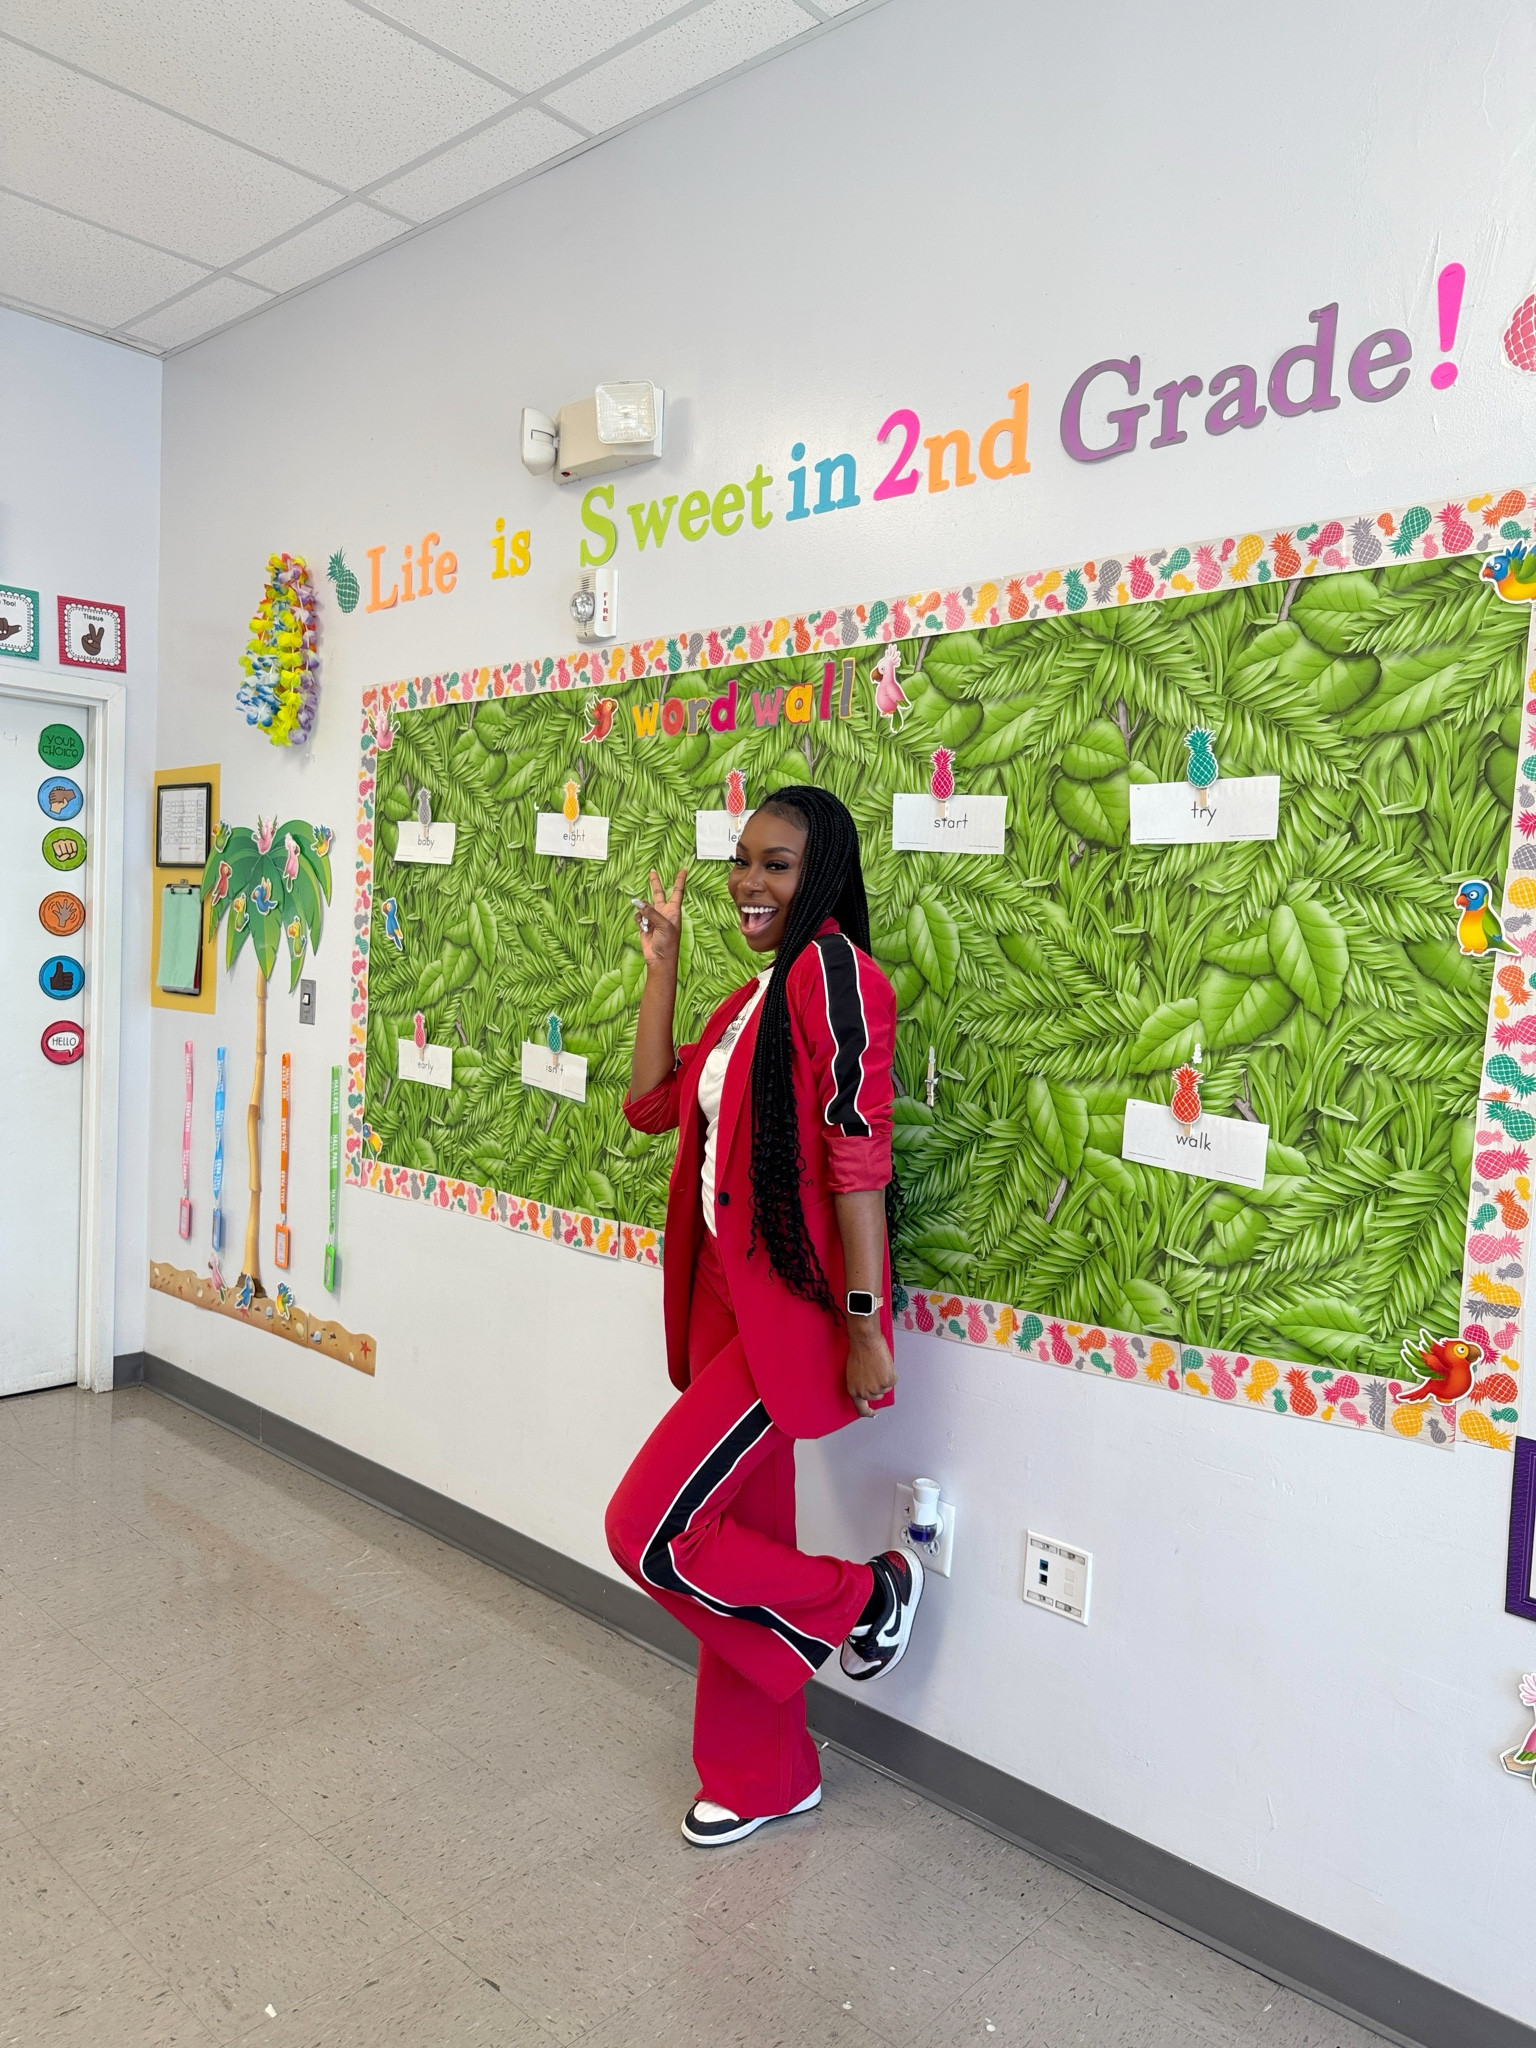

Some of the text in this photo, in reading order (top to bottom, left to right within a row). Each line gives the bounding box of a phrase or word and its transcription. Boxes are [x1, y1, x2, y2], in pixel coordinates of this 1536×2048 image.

[365, 262, 1466, 613] Life is Sweet in 2nd Grade!
[83, 613, 104, 622] Tissue
[632, 657, 856, 739] word wall
[46, 735, 76, 748] YOUR
[934, 813, 969, 829] start
[1191, 801, 1217, 826] try
[417, 834, 435, 851] baby
[563, 829, 587, 847] eight
[52, 1036, 77, 1047] HELLO
[417, 1061, 434, 1076] early
[1176, 1132, 1212, 1151] walk
